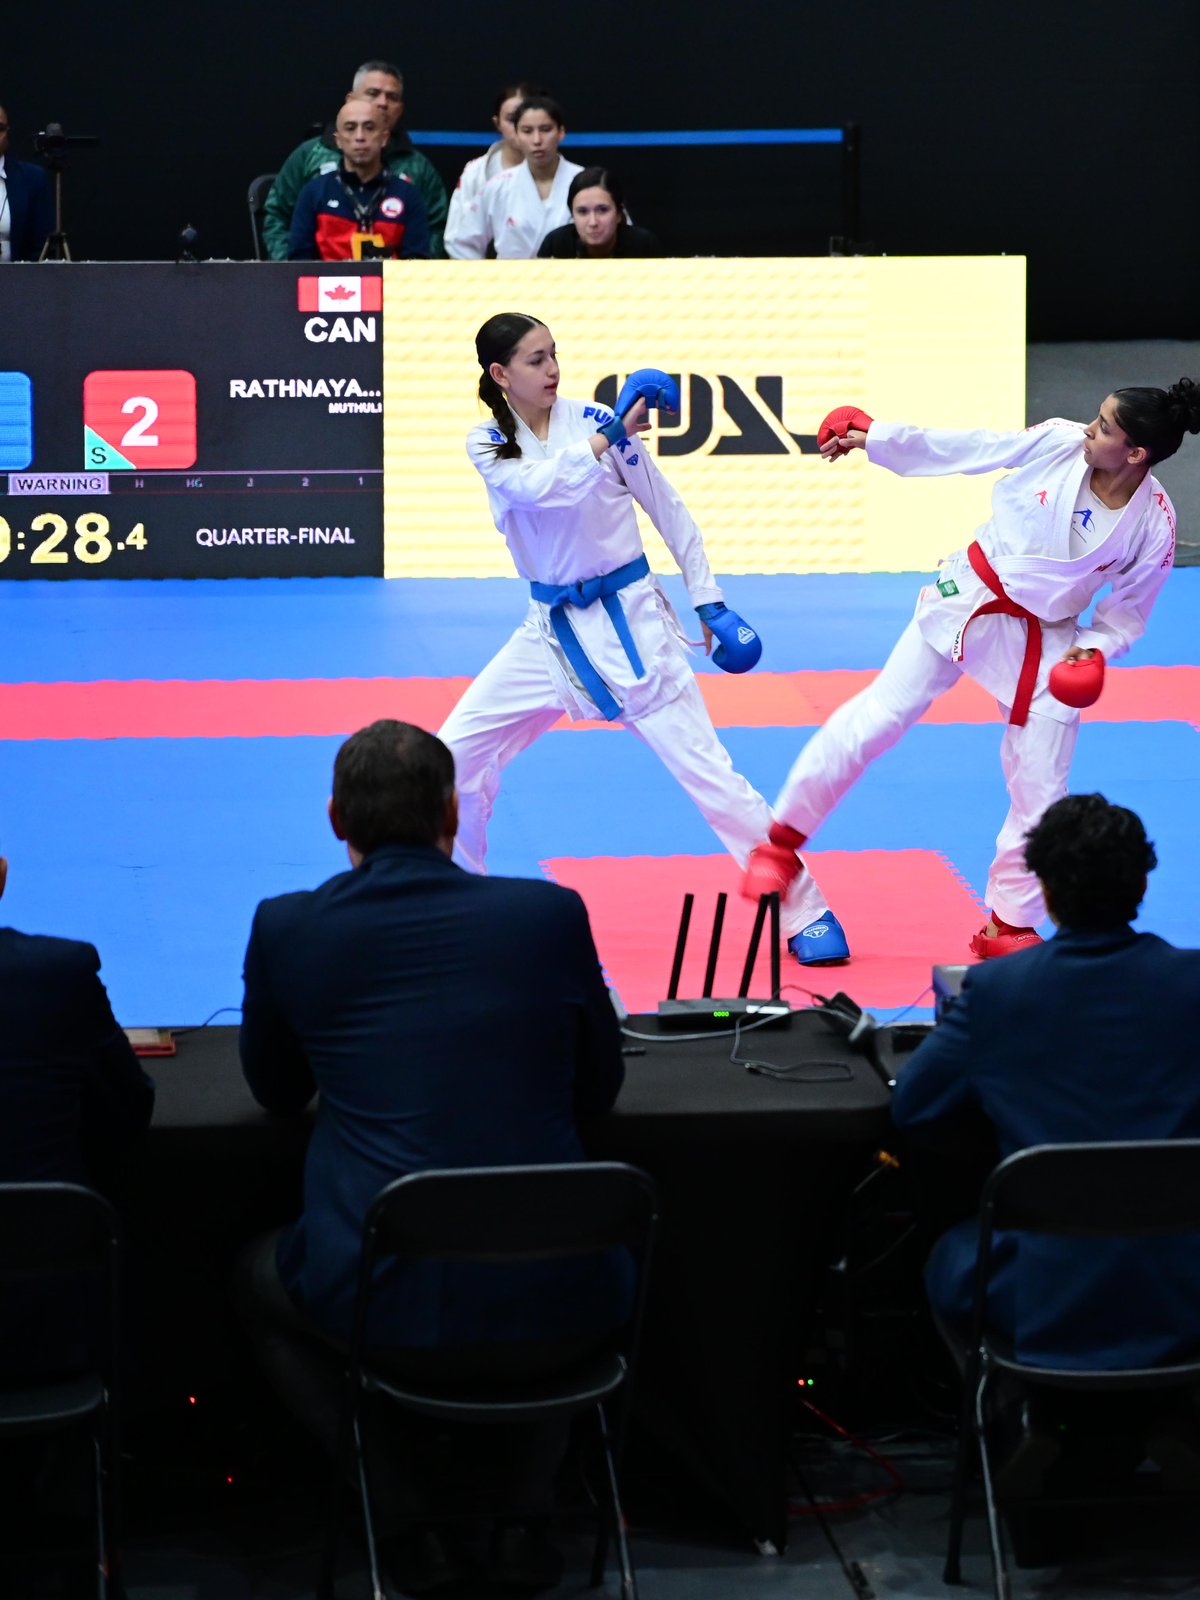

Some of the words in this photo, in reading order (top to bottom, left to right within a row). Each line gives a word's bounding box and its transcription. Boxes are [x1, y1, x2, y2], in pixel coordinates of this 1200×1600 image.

[304, 317, 376, 343] CAN
[229, 379, 381, 398] RATHNAYA...
[328, 402, 383, 414] MUTHULI
[121, 396, 159, 447] 2
[90, 446, 107, 465] S
[17, 478, 102, 490] WARNING
[135, 479, 144, 488] H
[302, 477, 309, 487] 2
[358, 476, 363, 486] 1
[196, 528, 356, 546] QUARTER-FINAL
